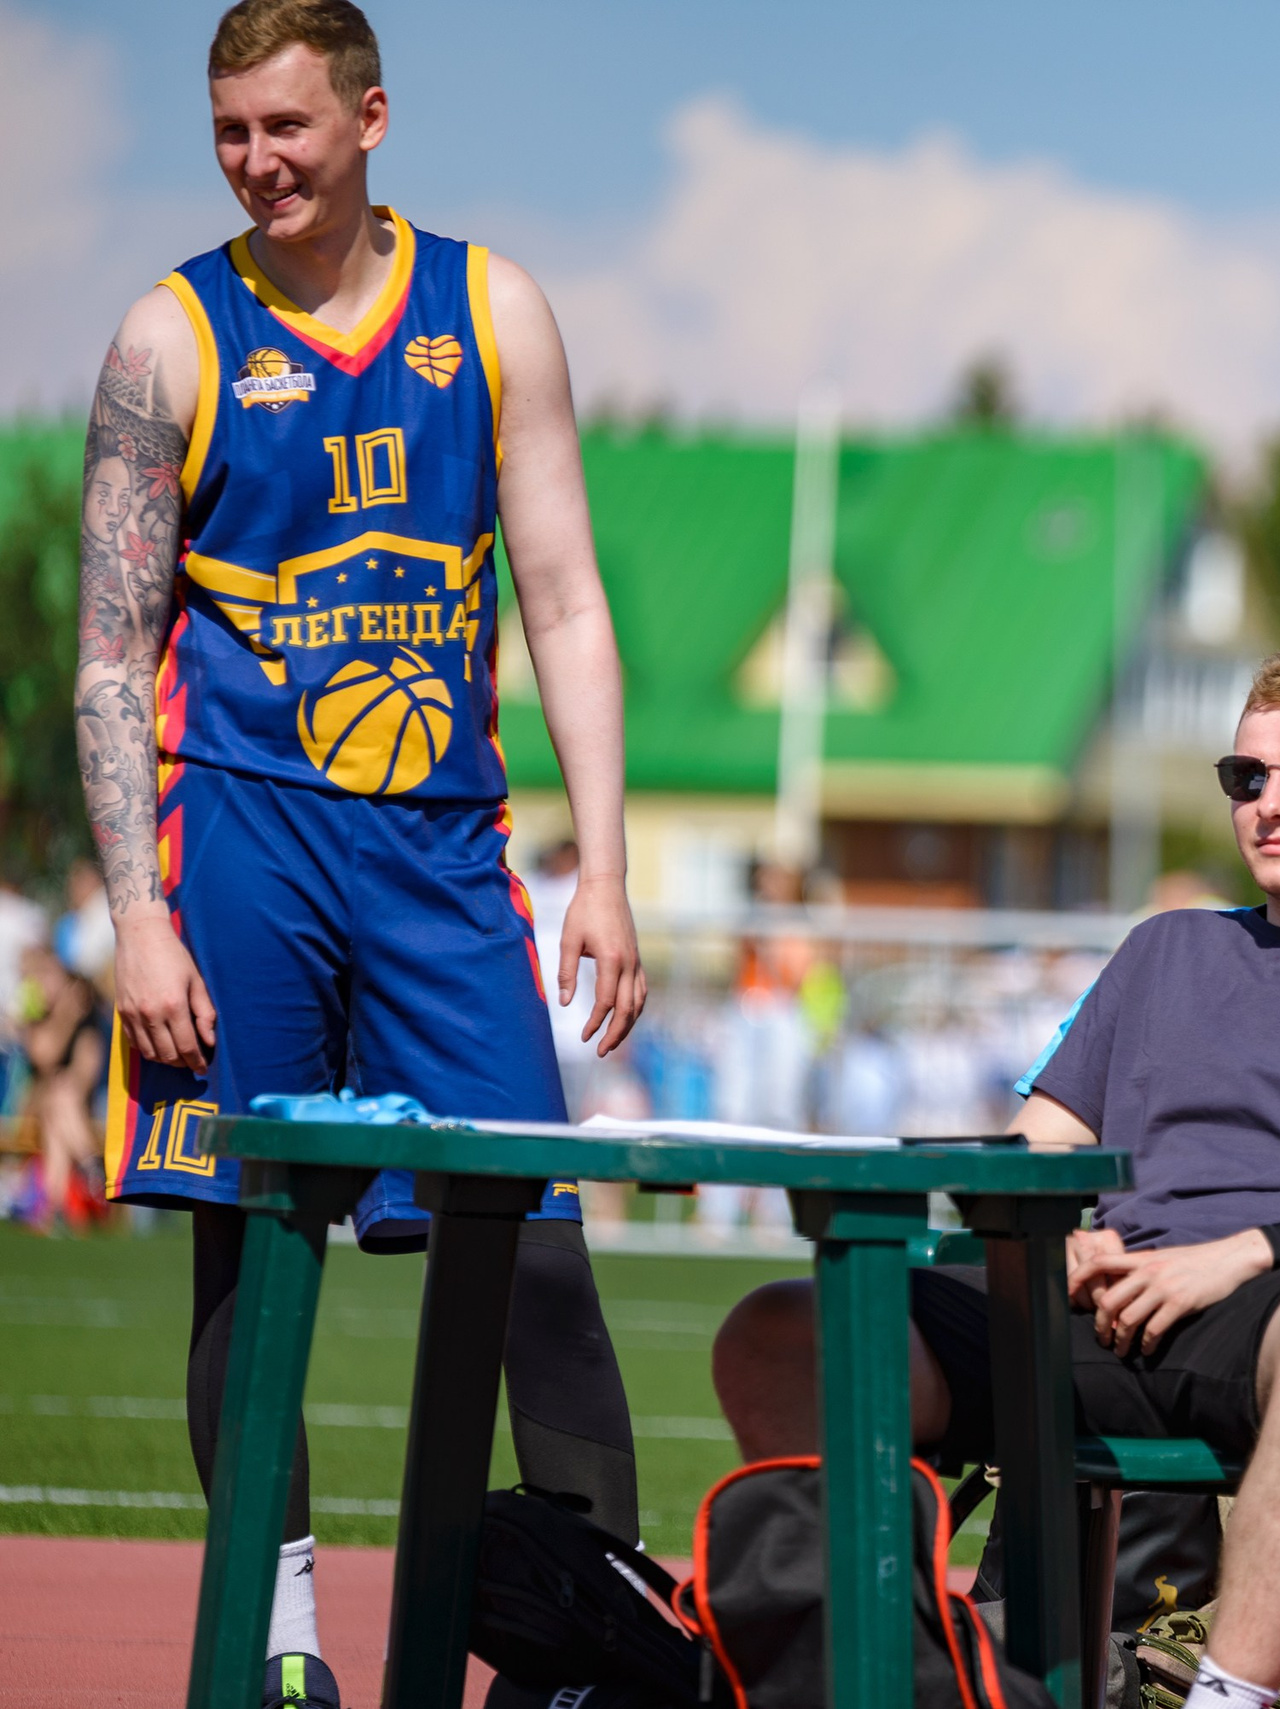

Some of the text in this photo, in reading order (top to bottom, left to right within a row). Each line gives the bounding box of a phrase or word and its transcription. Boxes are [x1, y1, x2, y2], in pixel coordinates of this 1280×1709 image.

[323, 427, 407, 514] 10
[271, 602, 466, 649] ЛЕГЕНДА
[137, 1098, 219, 1177] 10
